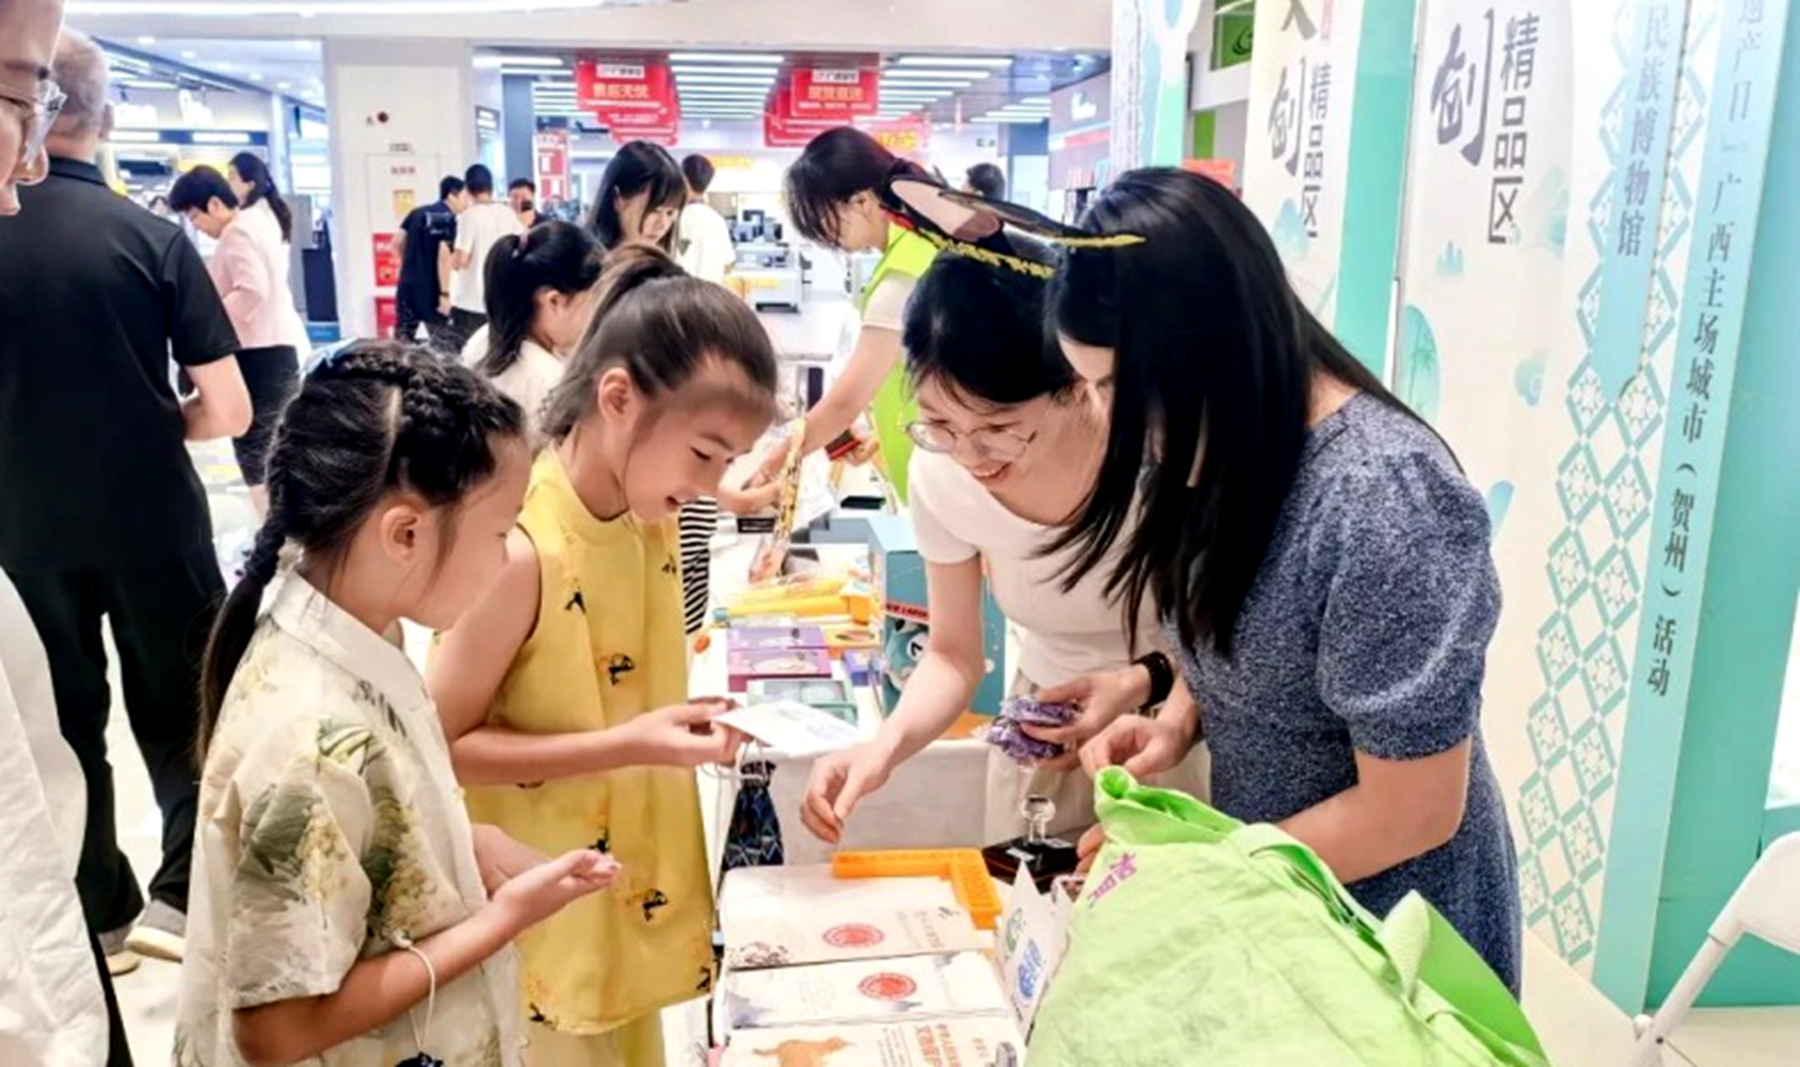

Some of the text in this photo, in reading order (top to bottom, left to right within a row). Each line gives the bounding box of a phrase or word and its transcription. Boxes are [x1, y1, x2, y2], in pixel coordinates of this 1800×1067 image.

[1302, 61, 1333, 239] 精品区
[1430, 7, 1496, 167] 创
[1487, 12, 1540, 245] 精品区
[1616, 3, 1670, 257] 民族博物馆
